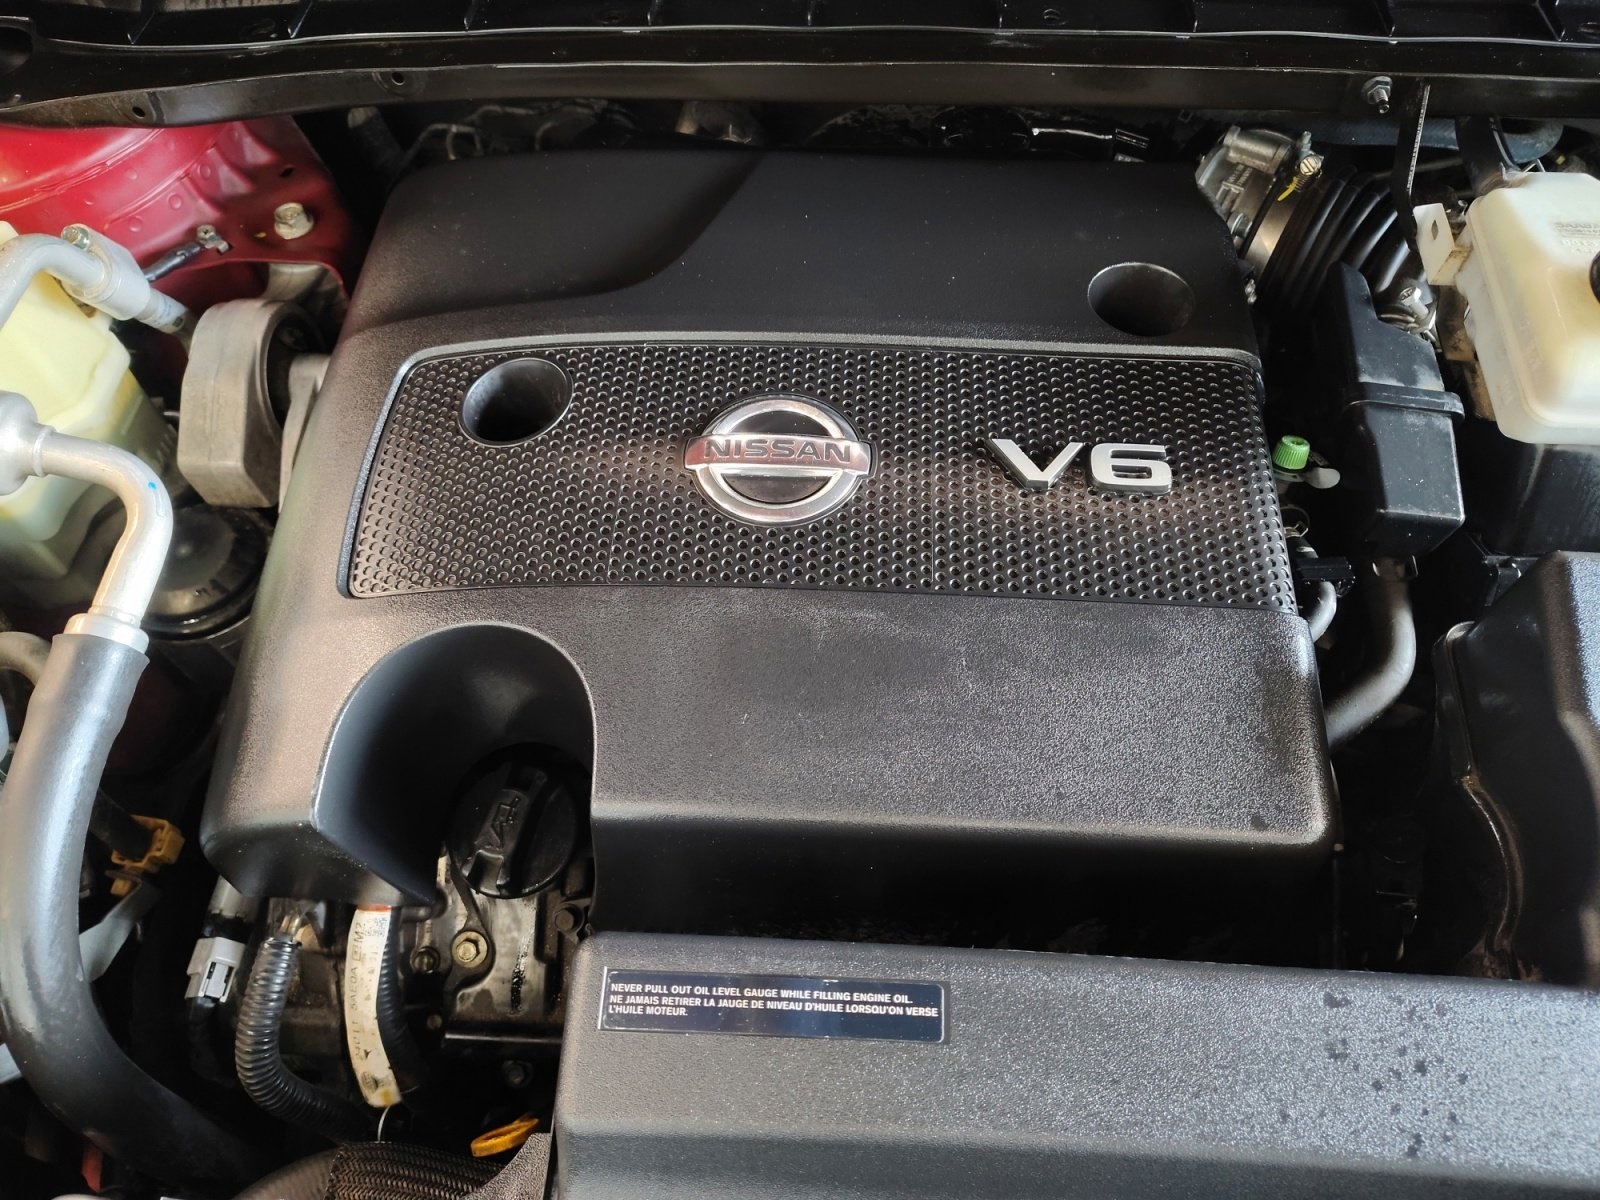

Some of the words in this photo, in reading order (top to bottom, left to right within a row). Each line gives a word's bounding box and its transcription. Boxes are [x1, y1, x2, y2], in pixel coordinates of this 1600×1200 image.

[702, 437, 852, 464] NISSAN
[987, 438, 1172, 495] V6
[610, 983, 642, 993] NEVER
[645, 984, 668, 994] PULL
[671, 985, 692, 994] OUT
[694, 986, 710, 995] OIL
[712, 987, 741, 996] LEVEL
[744, 988, 778, 998] GAUGE
[780, 989, 811, 999] WHILE
[813, 991, 851, 1001] FILLING
[853, 992, 891, 1003] ENGINE
[893, 994, 913, 1004] OIL.
[608, 1005, 644, 1014] L'HUILE
[646, 1006, 688, 1016] MOTEUR.
[609, 995, 623, 1004] NE
[625, 996, 659, 1005] JAMAIS
[662, 997, 701, 1006] RETIRER
[704, 998, 715, 1007] LA
[717, 999, 749, 1008] JAUGE
[751, 1000, 764, 1009] DE
[766, 1001, 802, 1011] NIVEAU
[804, 1002, 844, 1012] D'HUILE
[845, 1004, 903, 1015] LORSQU'ON
[906, 1006, 939, 1017] VERSE
